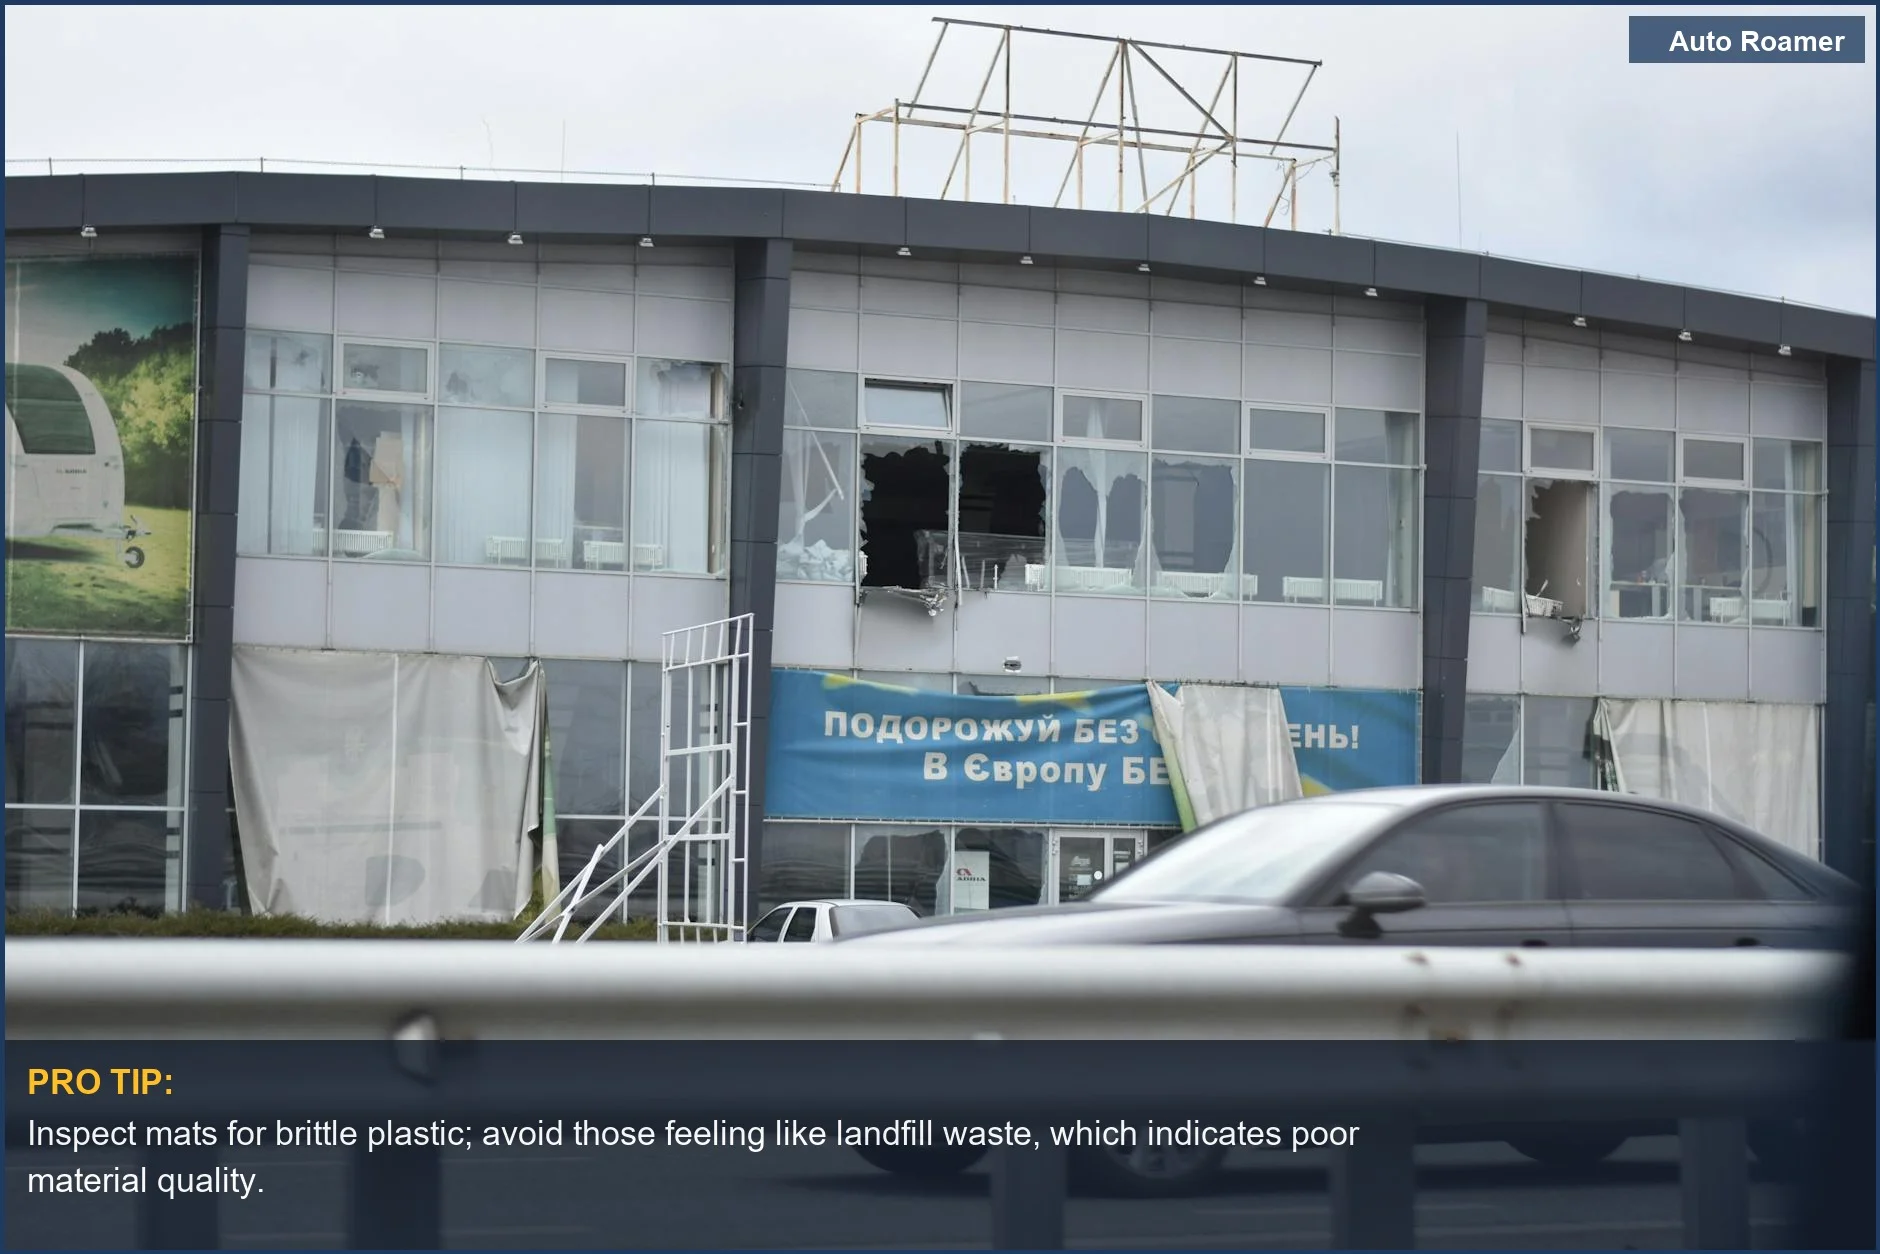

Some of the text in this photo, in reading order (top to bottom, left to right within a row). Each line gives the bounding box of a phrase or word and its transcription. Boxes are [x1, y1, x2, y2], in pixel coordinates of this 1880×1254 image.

[824, 710, 1061, 744] ПОДОРОЖУЙ
[1074, 718, 1139, 744] БЕЗ
[923, 751, 1170, 792] В Європу БЕ
